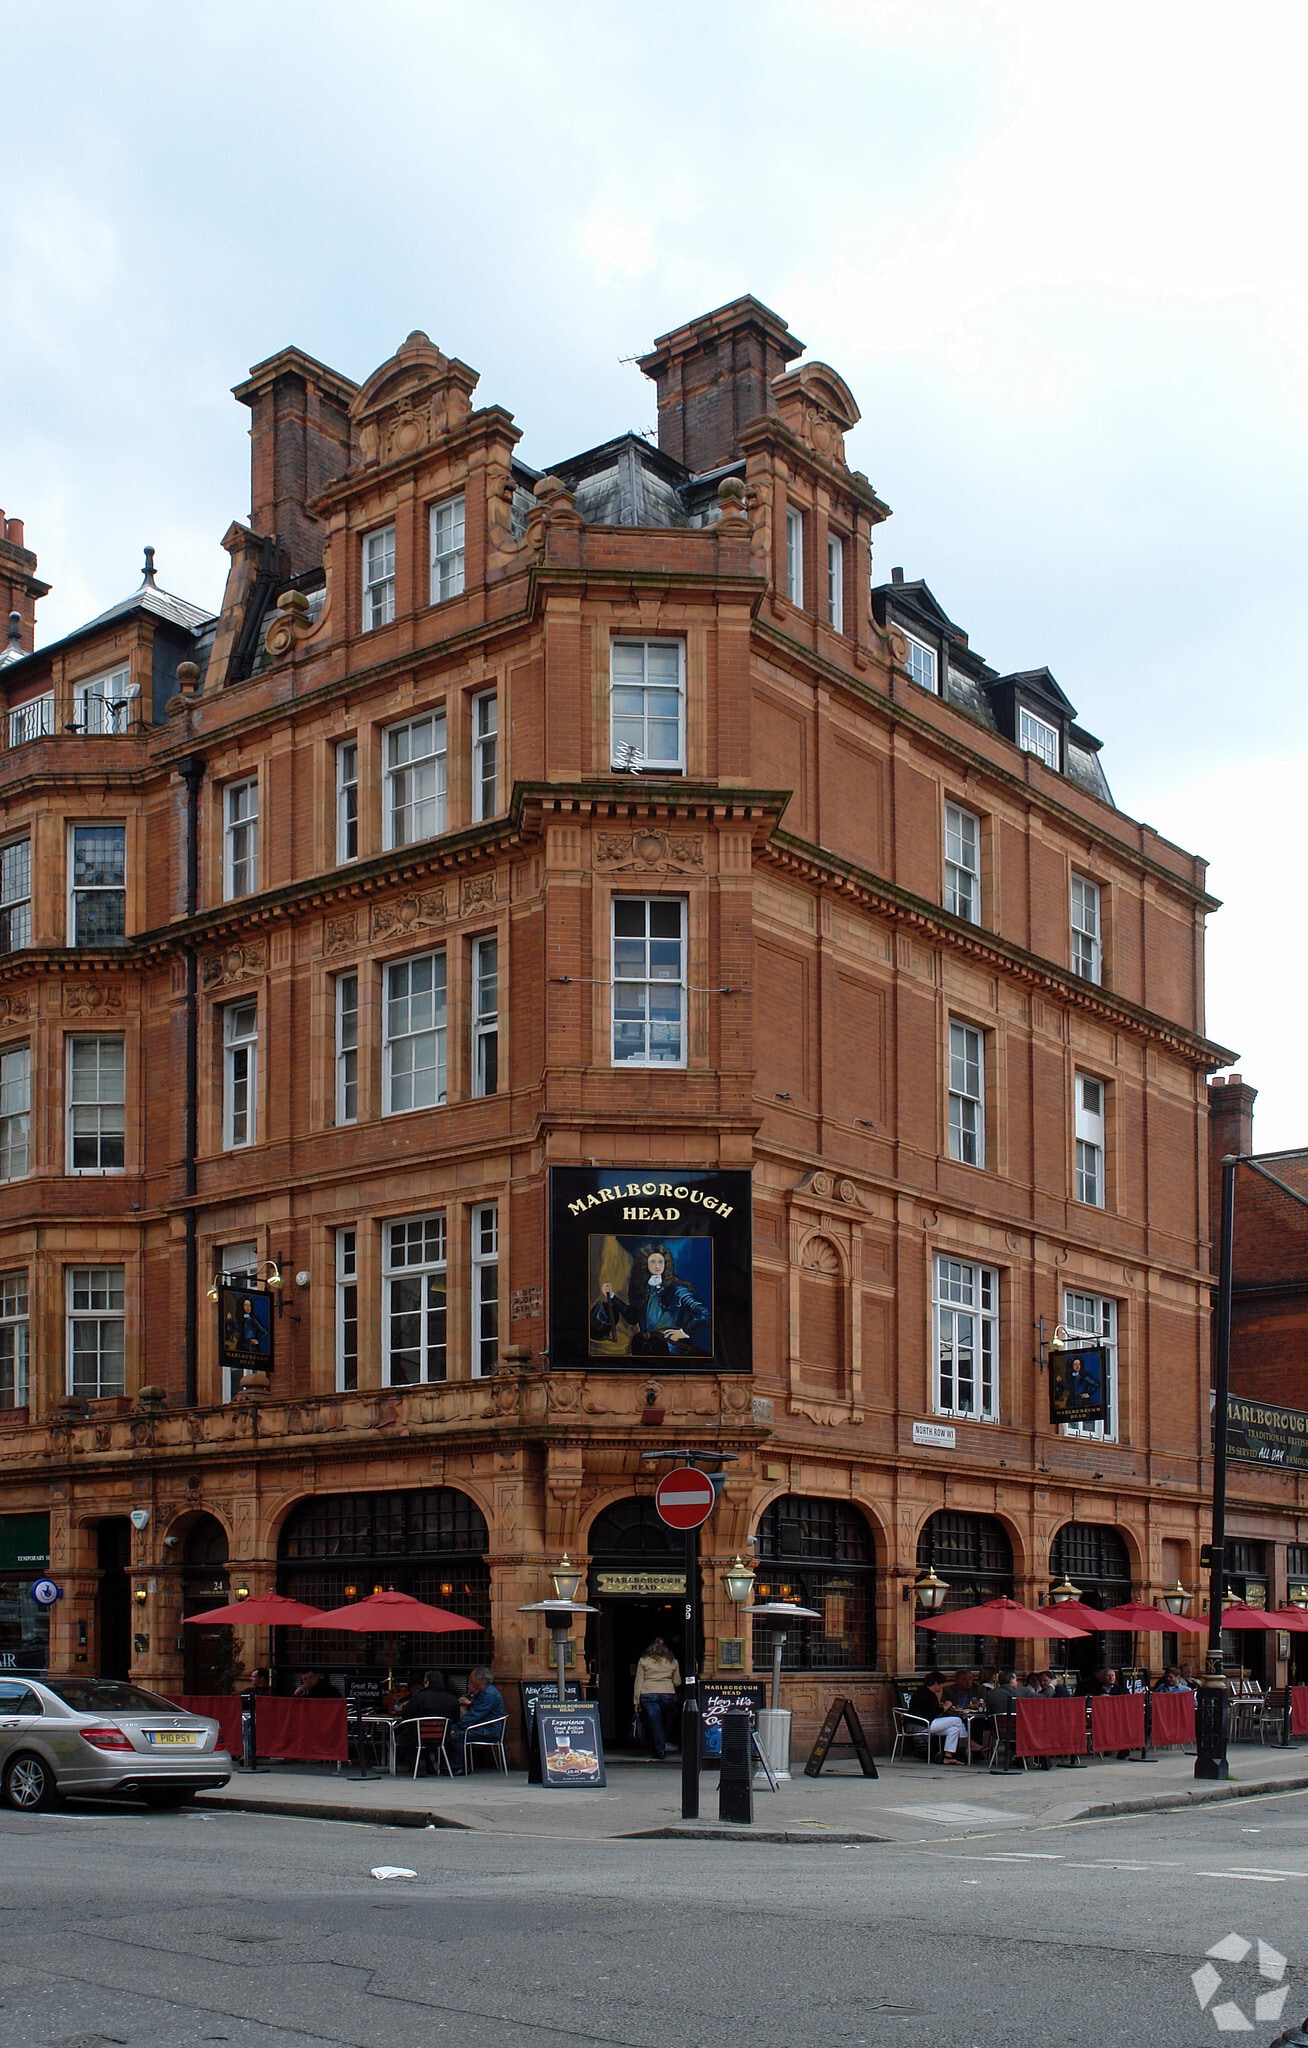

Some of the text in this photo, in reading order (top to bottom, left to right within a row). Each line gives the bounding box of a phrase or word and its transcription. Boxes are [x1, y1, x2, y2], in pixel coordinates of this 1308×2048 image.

[568, 1182, 734, 1216] MARLBOROUGH
[623, 1207, 681, 1221] HEAD
[915, 1425, 954, 1438] NORTH ROW W1
[1248, 1429, 1286, 1444] TRADITIONAL
[1236, 1447, 1257, 1459] SERVED
[1258, 1447, 1270, 1460] ALL
[1271, 1449, 1285, 1462] DAY
[213, 1581, 223, 1591] 24
[0, 1653, 17, 1667] IR
[160, 1733, 191, 1743] P10 PSY
